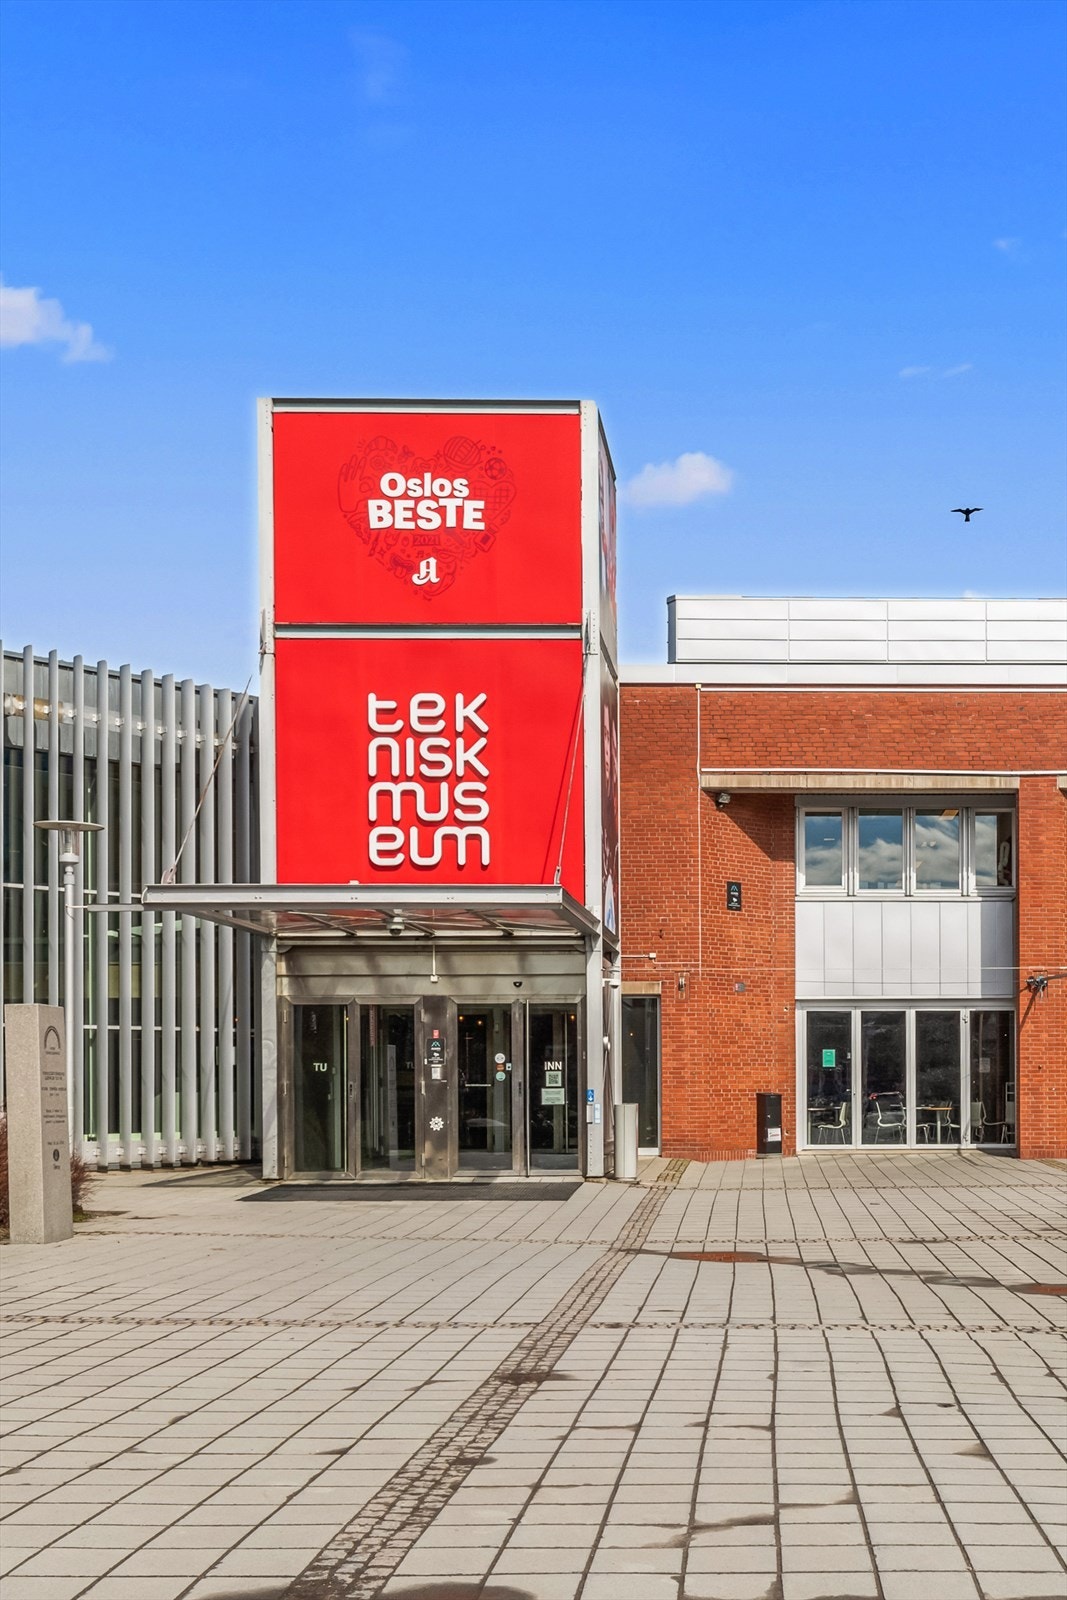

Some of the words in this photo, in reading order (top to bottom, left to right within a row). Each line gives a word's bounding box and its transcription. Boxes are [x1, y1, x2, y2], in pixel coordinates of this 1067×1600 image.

[380, 472, 470, 498] Oslos
[368, 498, 485, 530] BESTE
[544, 1061, 562, 1071] INN
